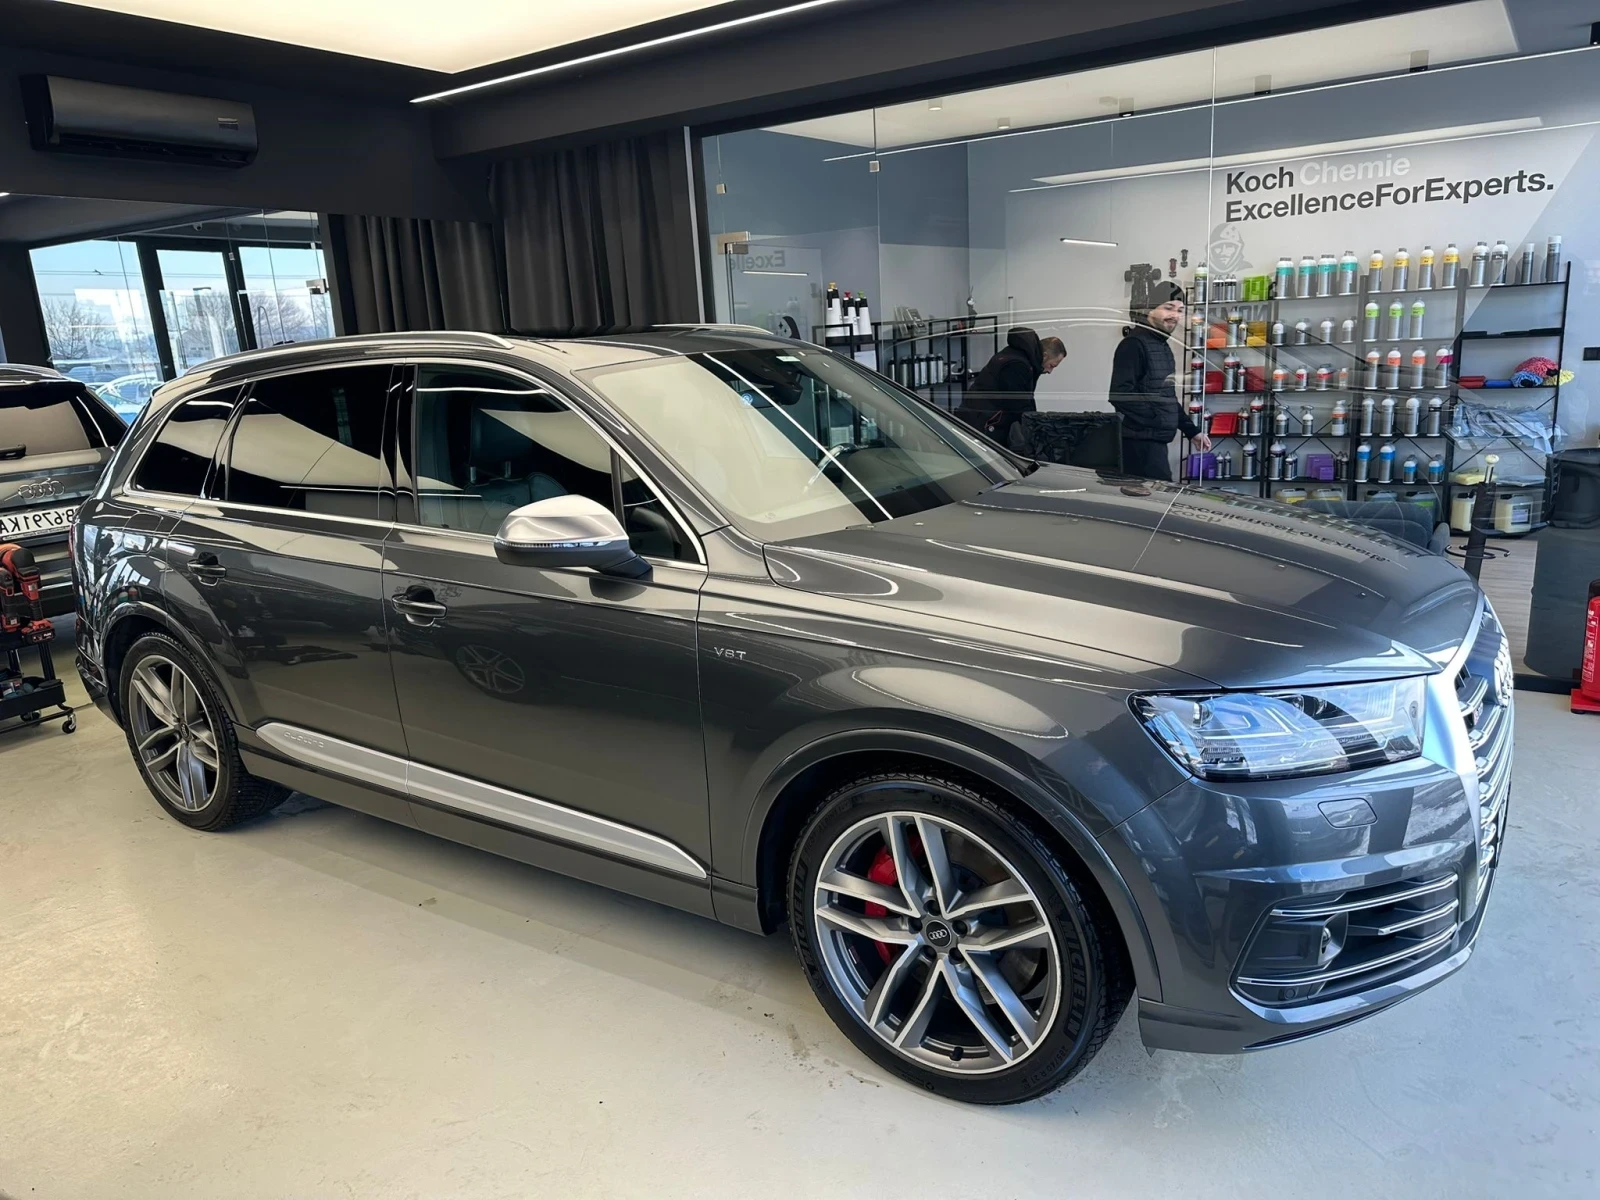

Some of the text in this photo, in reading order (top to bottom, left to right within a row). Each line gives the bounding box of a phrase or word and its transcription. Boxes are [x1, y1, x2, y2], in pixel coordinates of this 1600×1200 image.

[1226, 153, 1411, 195] Koch Chemie
[1226, 170, 1554, 222] ExcellenceForExperts.
[1060, 920, 1087, 1036] MICHELIN
